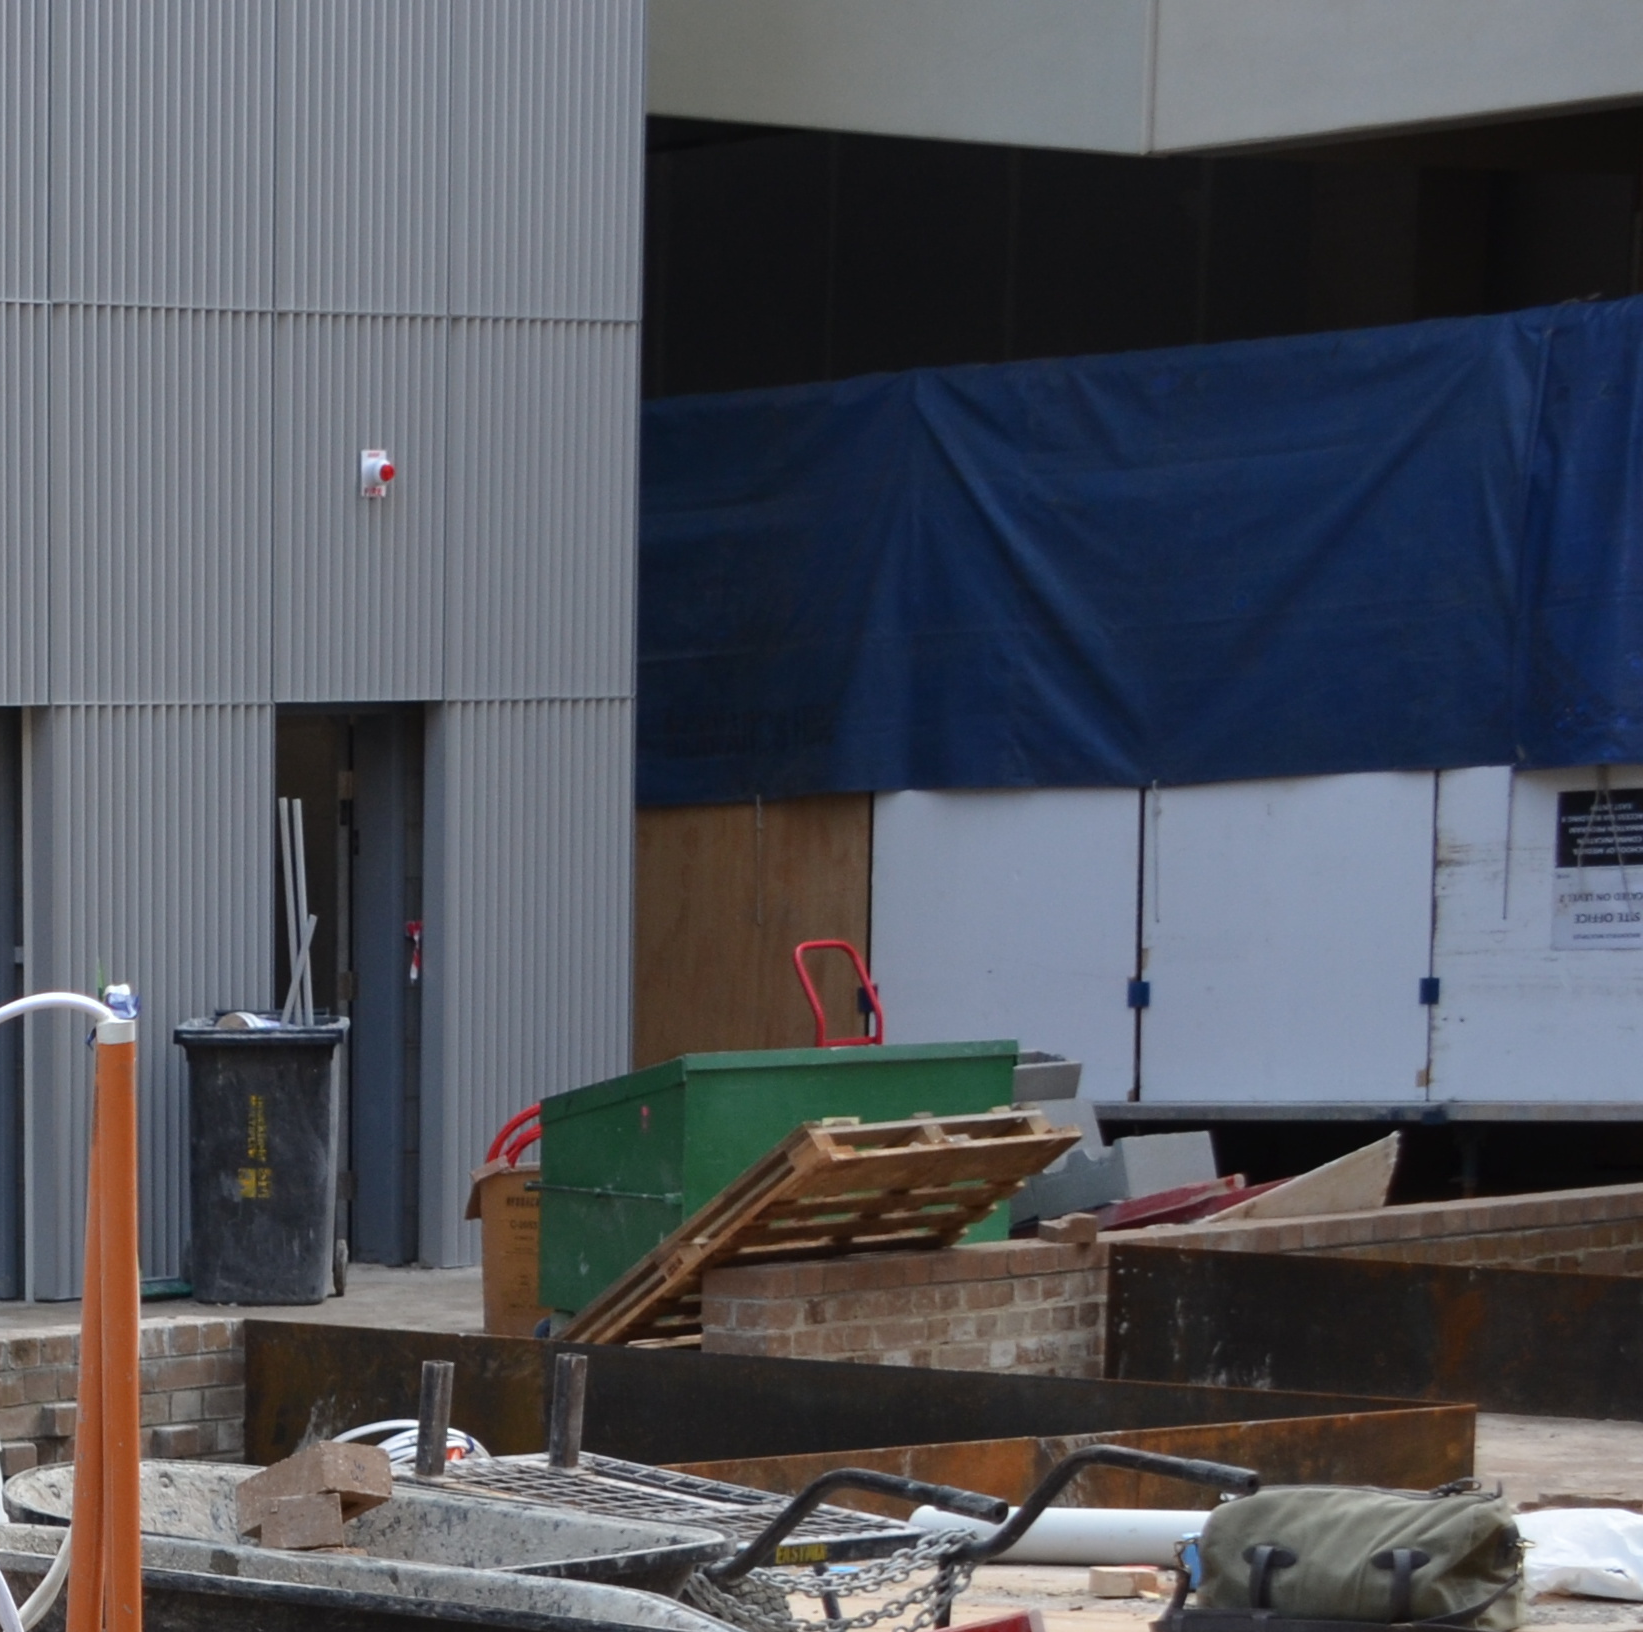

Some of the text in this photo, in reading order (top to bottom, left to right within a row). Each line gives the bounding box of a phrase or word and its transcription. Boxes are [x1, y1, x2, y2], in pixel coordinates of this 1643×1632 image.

[1596, 893, 1611, 901] ON
[1574, 912, 1641, 924] SITE OFFICE
